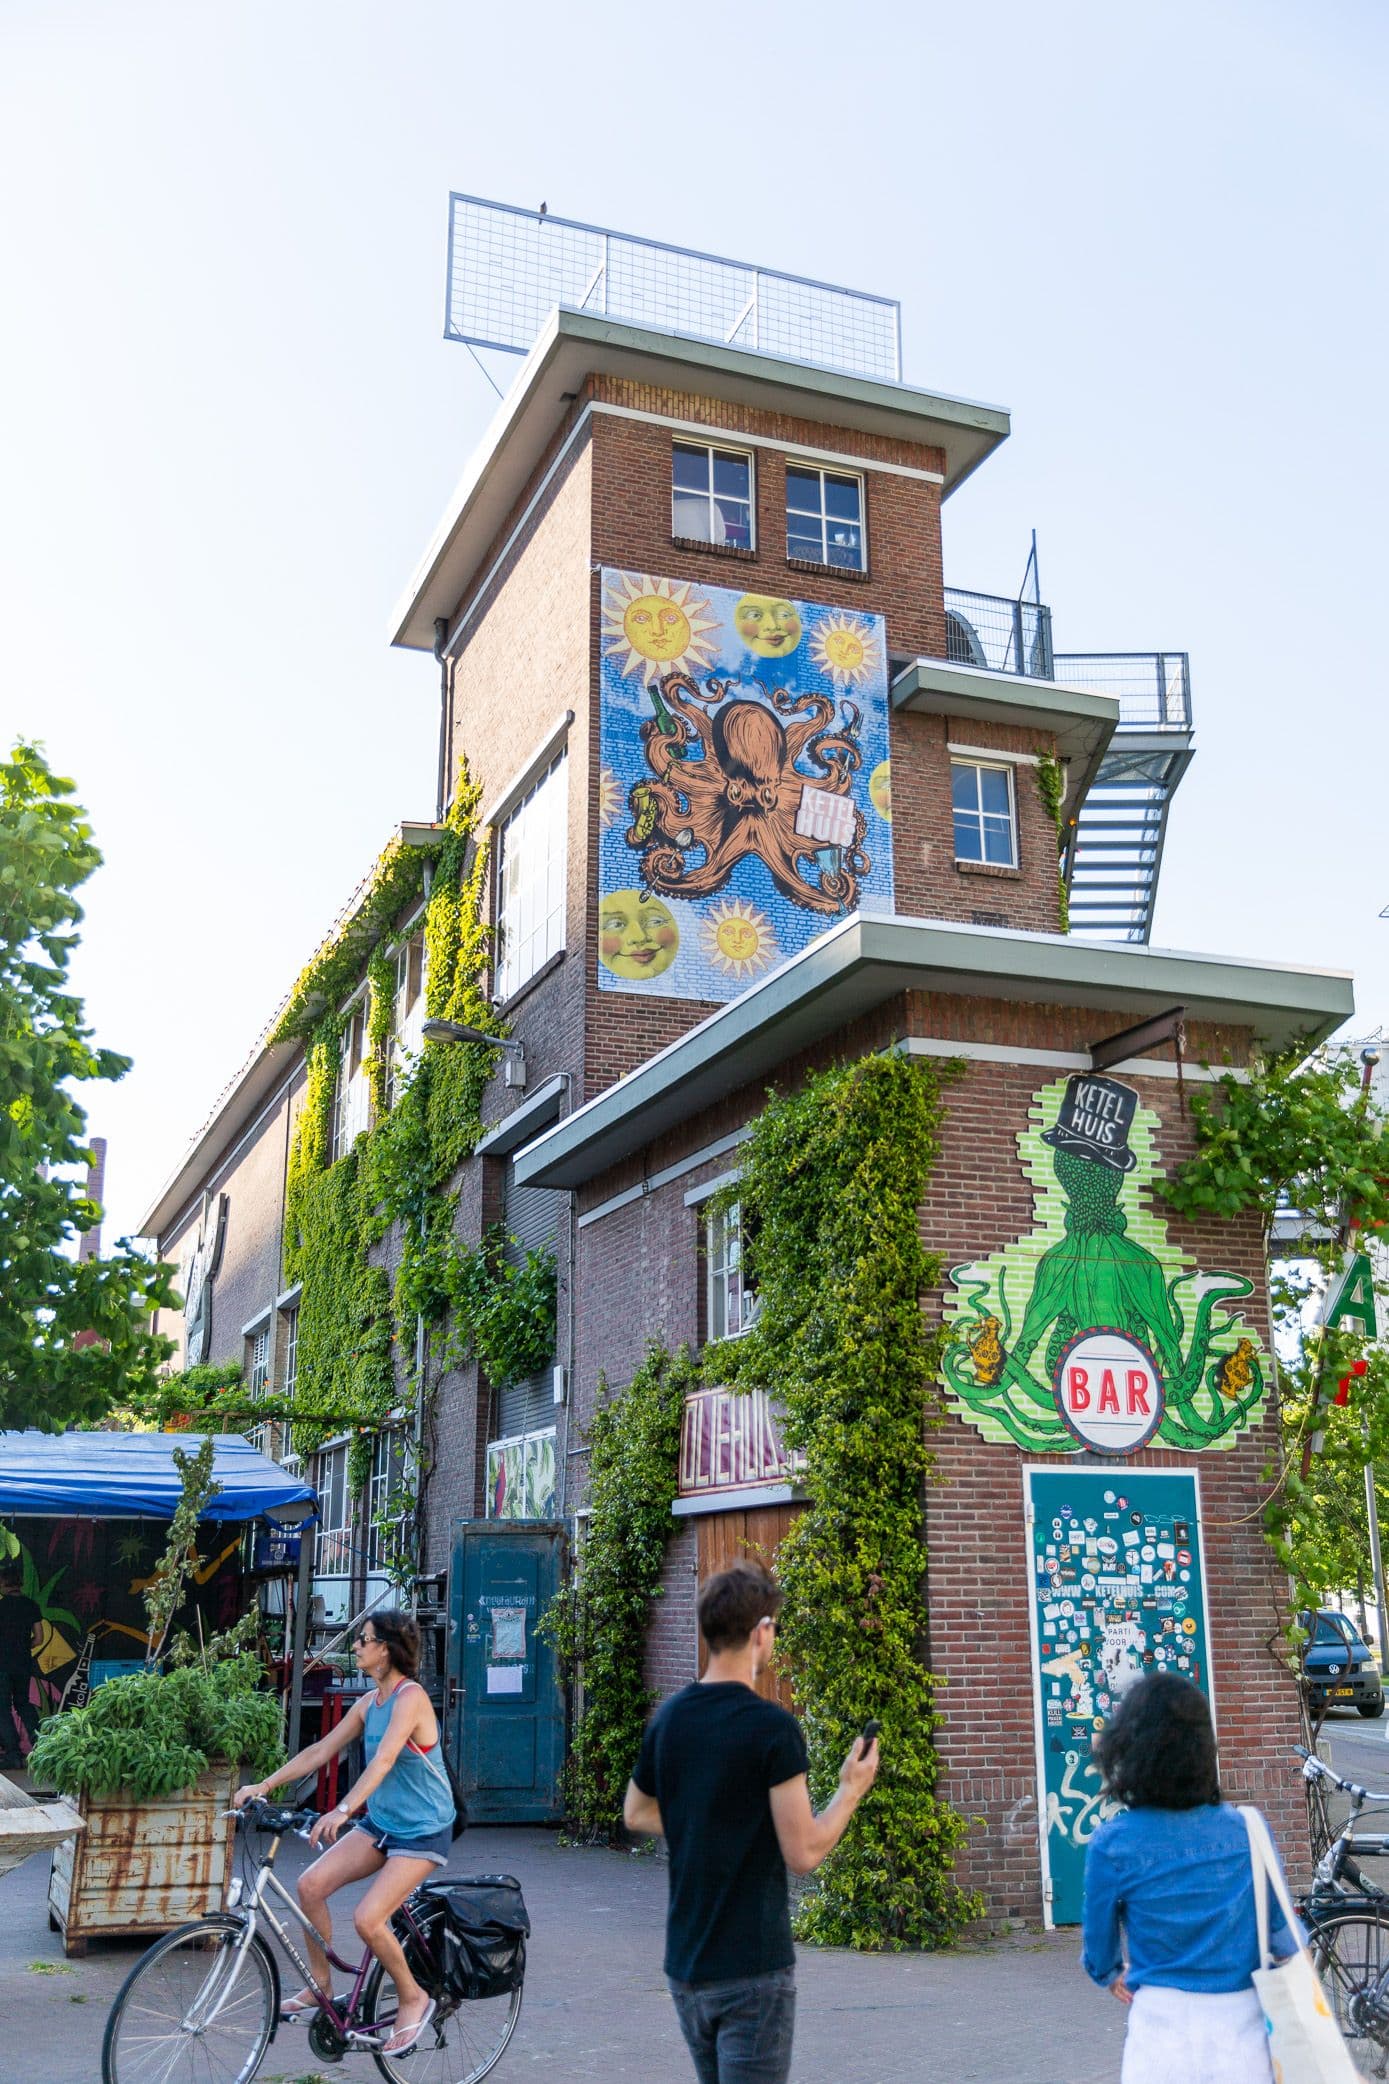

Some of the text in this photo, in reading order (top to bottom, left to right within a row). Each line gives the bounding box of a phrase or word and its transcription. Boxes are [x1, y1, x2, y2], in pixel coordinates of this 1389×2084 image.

[1074, 1081, 1125, 1125] KETEL
[1070, 1106, 1117, 1145] HUIS
[1066, 1366, 1151, 1416] BAR
